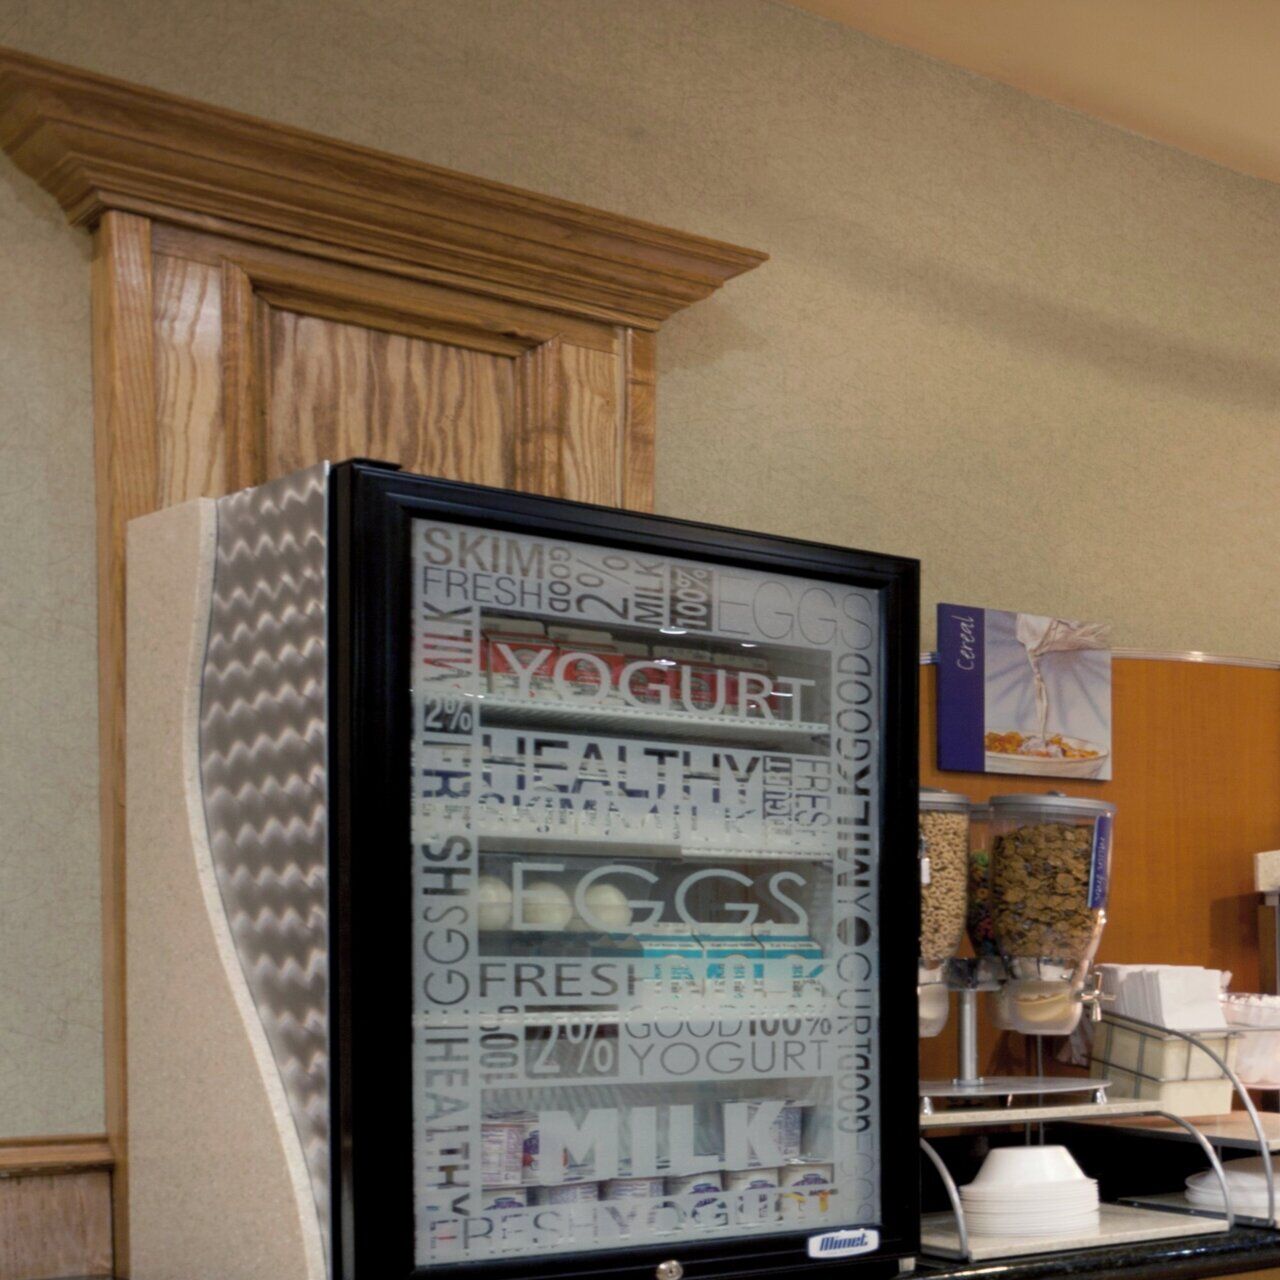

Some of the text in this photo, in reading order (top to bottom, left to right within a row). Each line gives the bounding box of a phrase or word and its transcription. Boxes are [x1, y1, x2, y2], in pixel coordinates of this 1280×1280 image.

[423, 526, 545, 580] SKIM
[423, 565, 543, 610] FRESH
[548, 545, 572, 614] GOOD
[575, 555, 631, 620] 2%
[634, 558, 665, 626] MILK
[675, 567, 708, 631] 100%
[717, 574, 873, 651] EGGS
[423, 601, 473, 688] MILK
[955, 614, 976, 671] Cereal
[425, 698, 472, 731] 2%
[496, 643, 816, 728] YOGURT
[837, 653, 873, 763] GOOD
[481, 733, 761, 804] HEALTHY
[422, 740, 473, 896] FRESH
[837, 763, 871, 889] MILK
[512, 862, 809, 932] EGGS
[423, 904, 470, 1030] EGGS
[479, 963, 662, 998] FRESH
[837, 891, 873, 1053] YOGURT
[532, 1012, 614, 1075] 2%
[625, 1004, 743, 1039] GOOD
[627, 1038, 829, 1077] YOGURT
[424, 1037, 471, 1217] HEALTHY
[837, 1053, 872, 1133] GOOD
[538, 1101, 787, 1186] MILK
